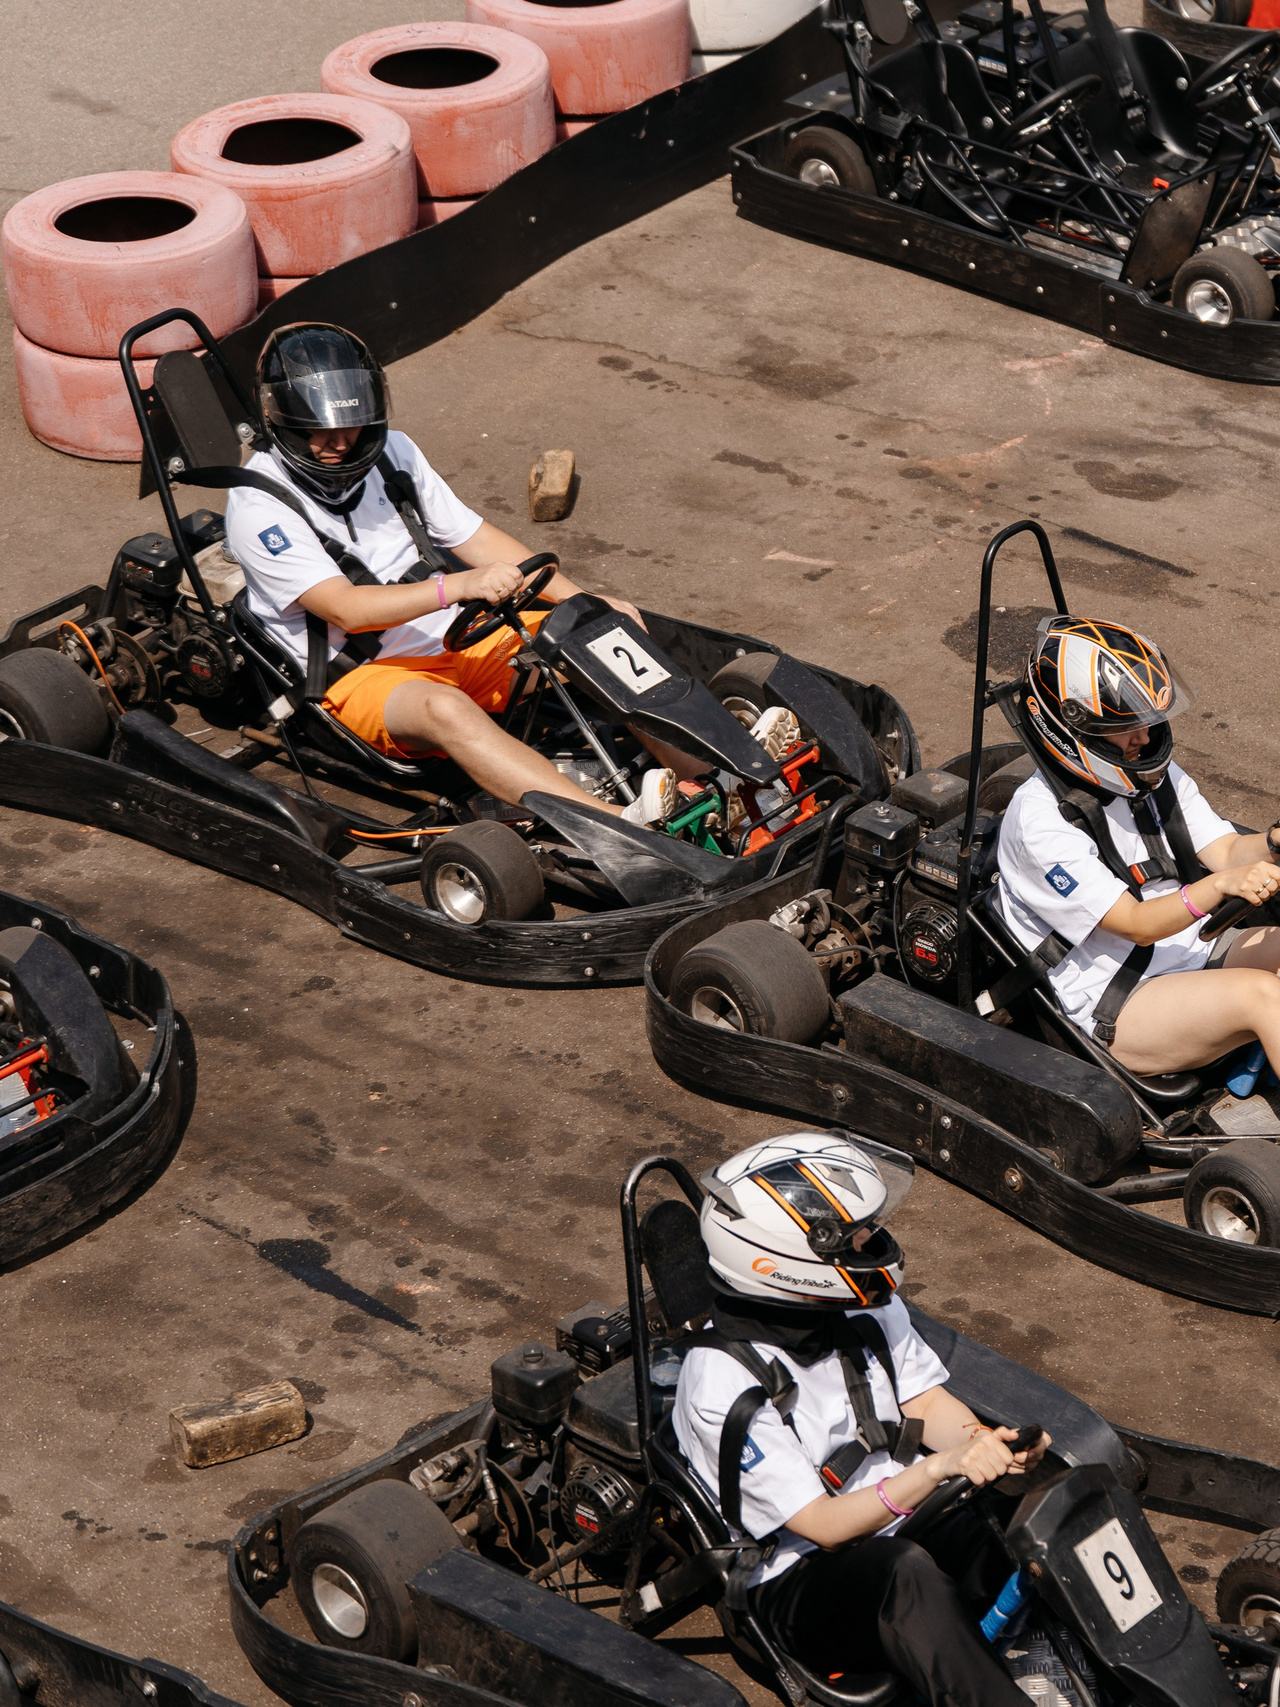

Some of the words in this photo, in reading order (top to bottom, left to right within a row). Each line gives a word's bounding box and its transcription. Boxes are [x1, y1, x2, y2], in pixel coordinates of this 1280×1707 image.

[328, 398, 359, 408] ATAKI
[613, 645, 650, 678] 2
[915, 941, 937, 953] HONDA
[915, 946, 937, 963] 6.5
[576, 1513, 599, 1534] 6.5
[1103, 1551, 1135, 1601] 9
